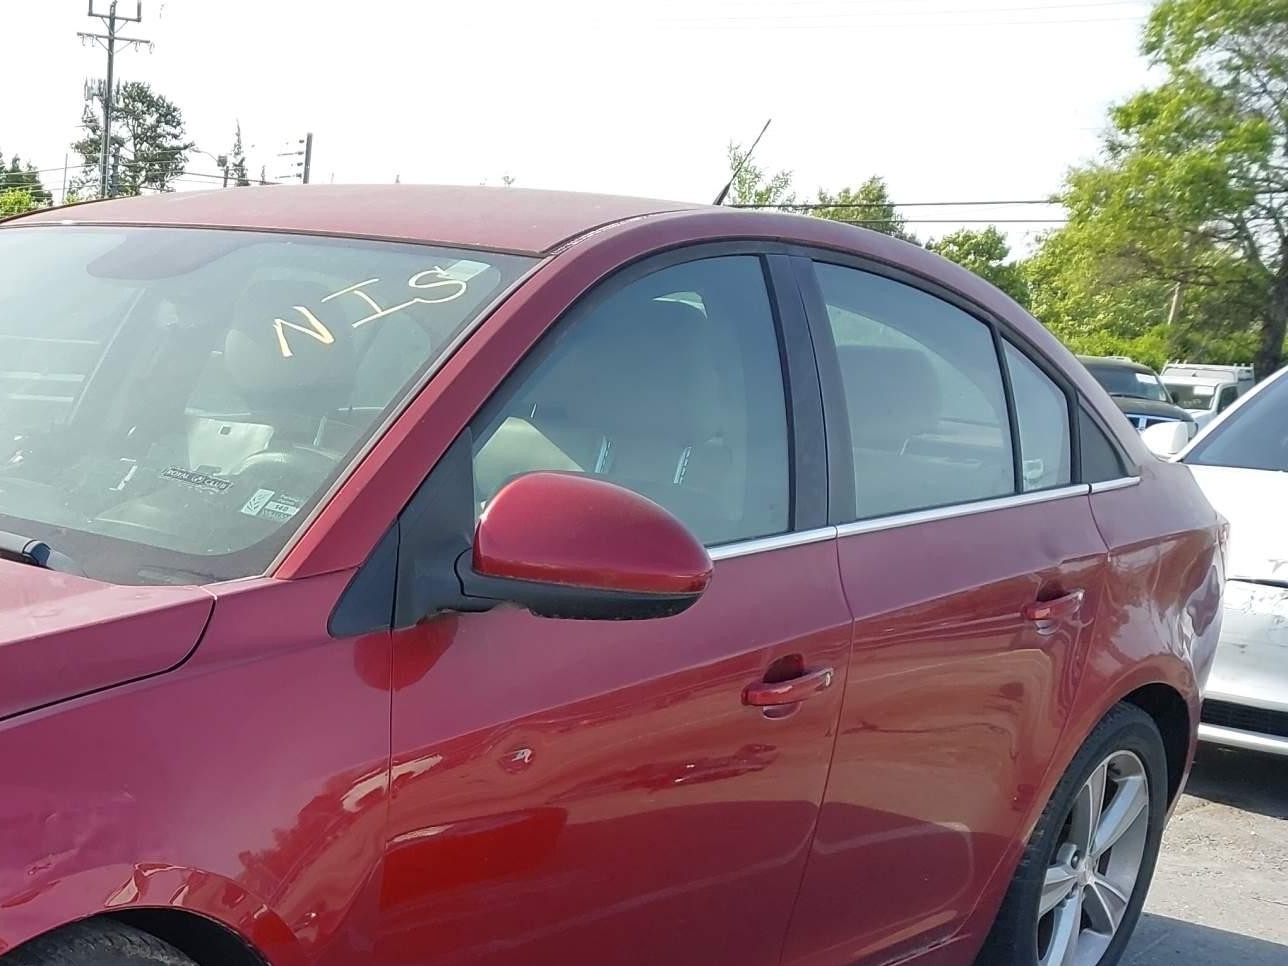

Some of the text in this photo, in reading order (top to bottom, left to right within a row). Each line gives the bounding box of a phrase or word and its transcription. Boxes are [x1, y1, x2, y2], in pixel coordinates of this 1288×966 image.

[272, 265, 467, 357] NIS
[166, 469, 190, 479] ROYAL
[204, 479, 227, 489] CLUB
